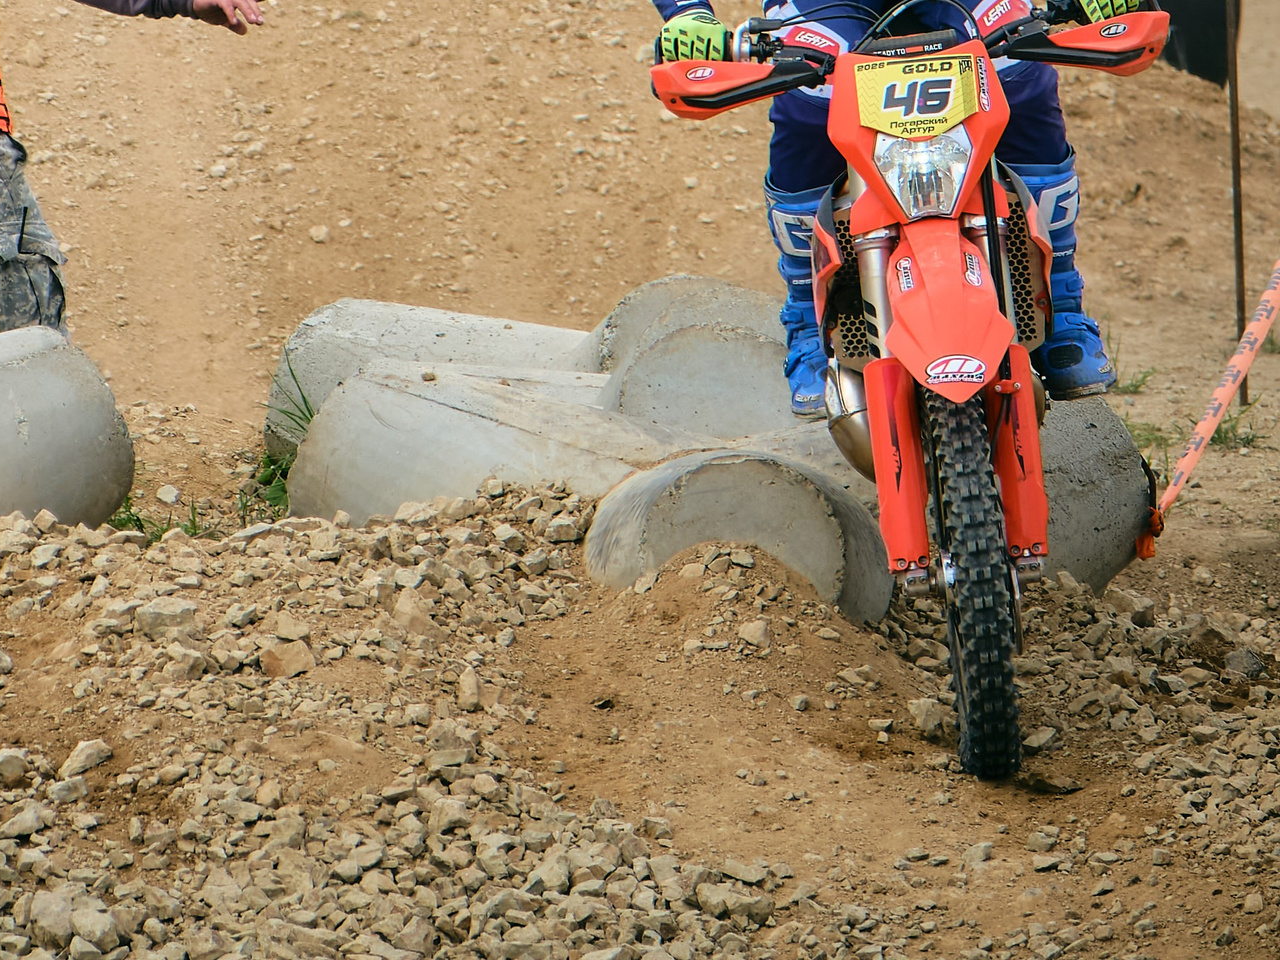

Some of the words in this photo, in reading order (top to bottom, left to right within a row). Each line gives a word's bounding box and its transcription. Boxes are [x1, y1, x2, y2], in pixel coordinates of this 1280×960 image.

[794, 30, 836, 48] LEATT
[895, 48, 906, 56] TO
[924, 43, 943, 52] RACE
[902, 61, 954, 75] GOLD
[883, 79, 952, 117] 46
[889, 117, 948, 129] Погарский
[900, 125, 936, 136] Артур
